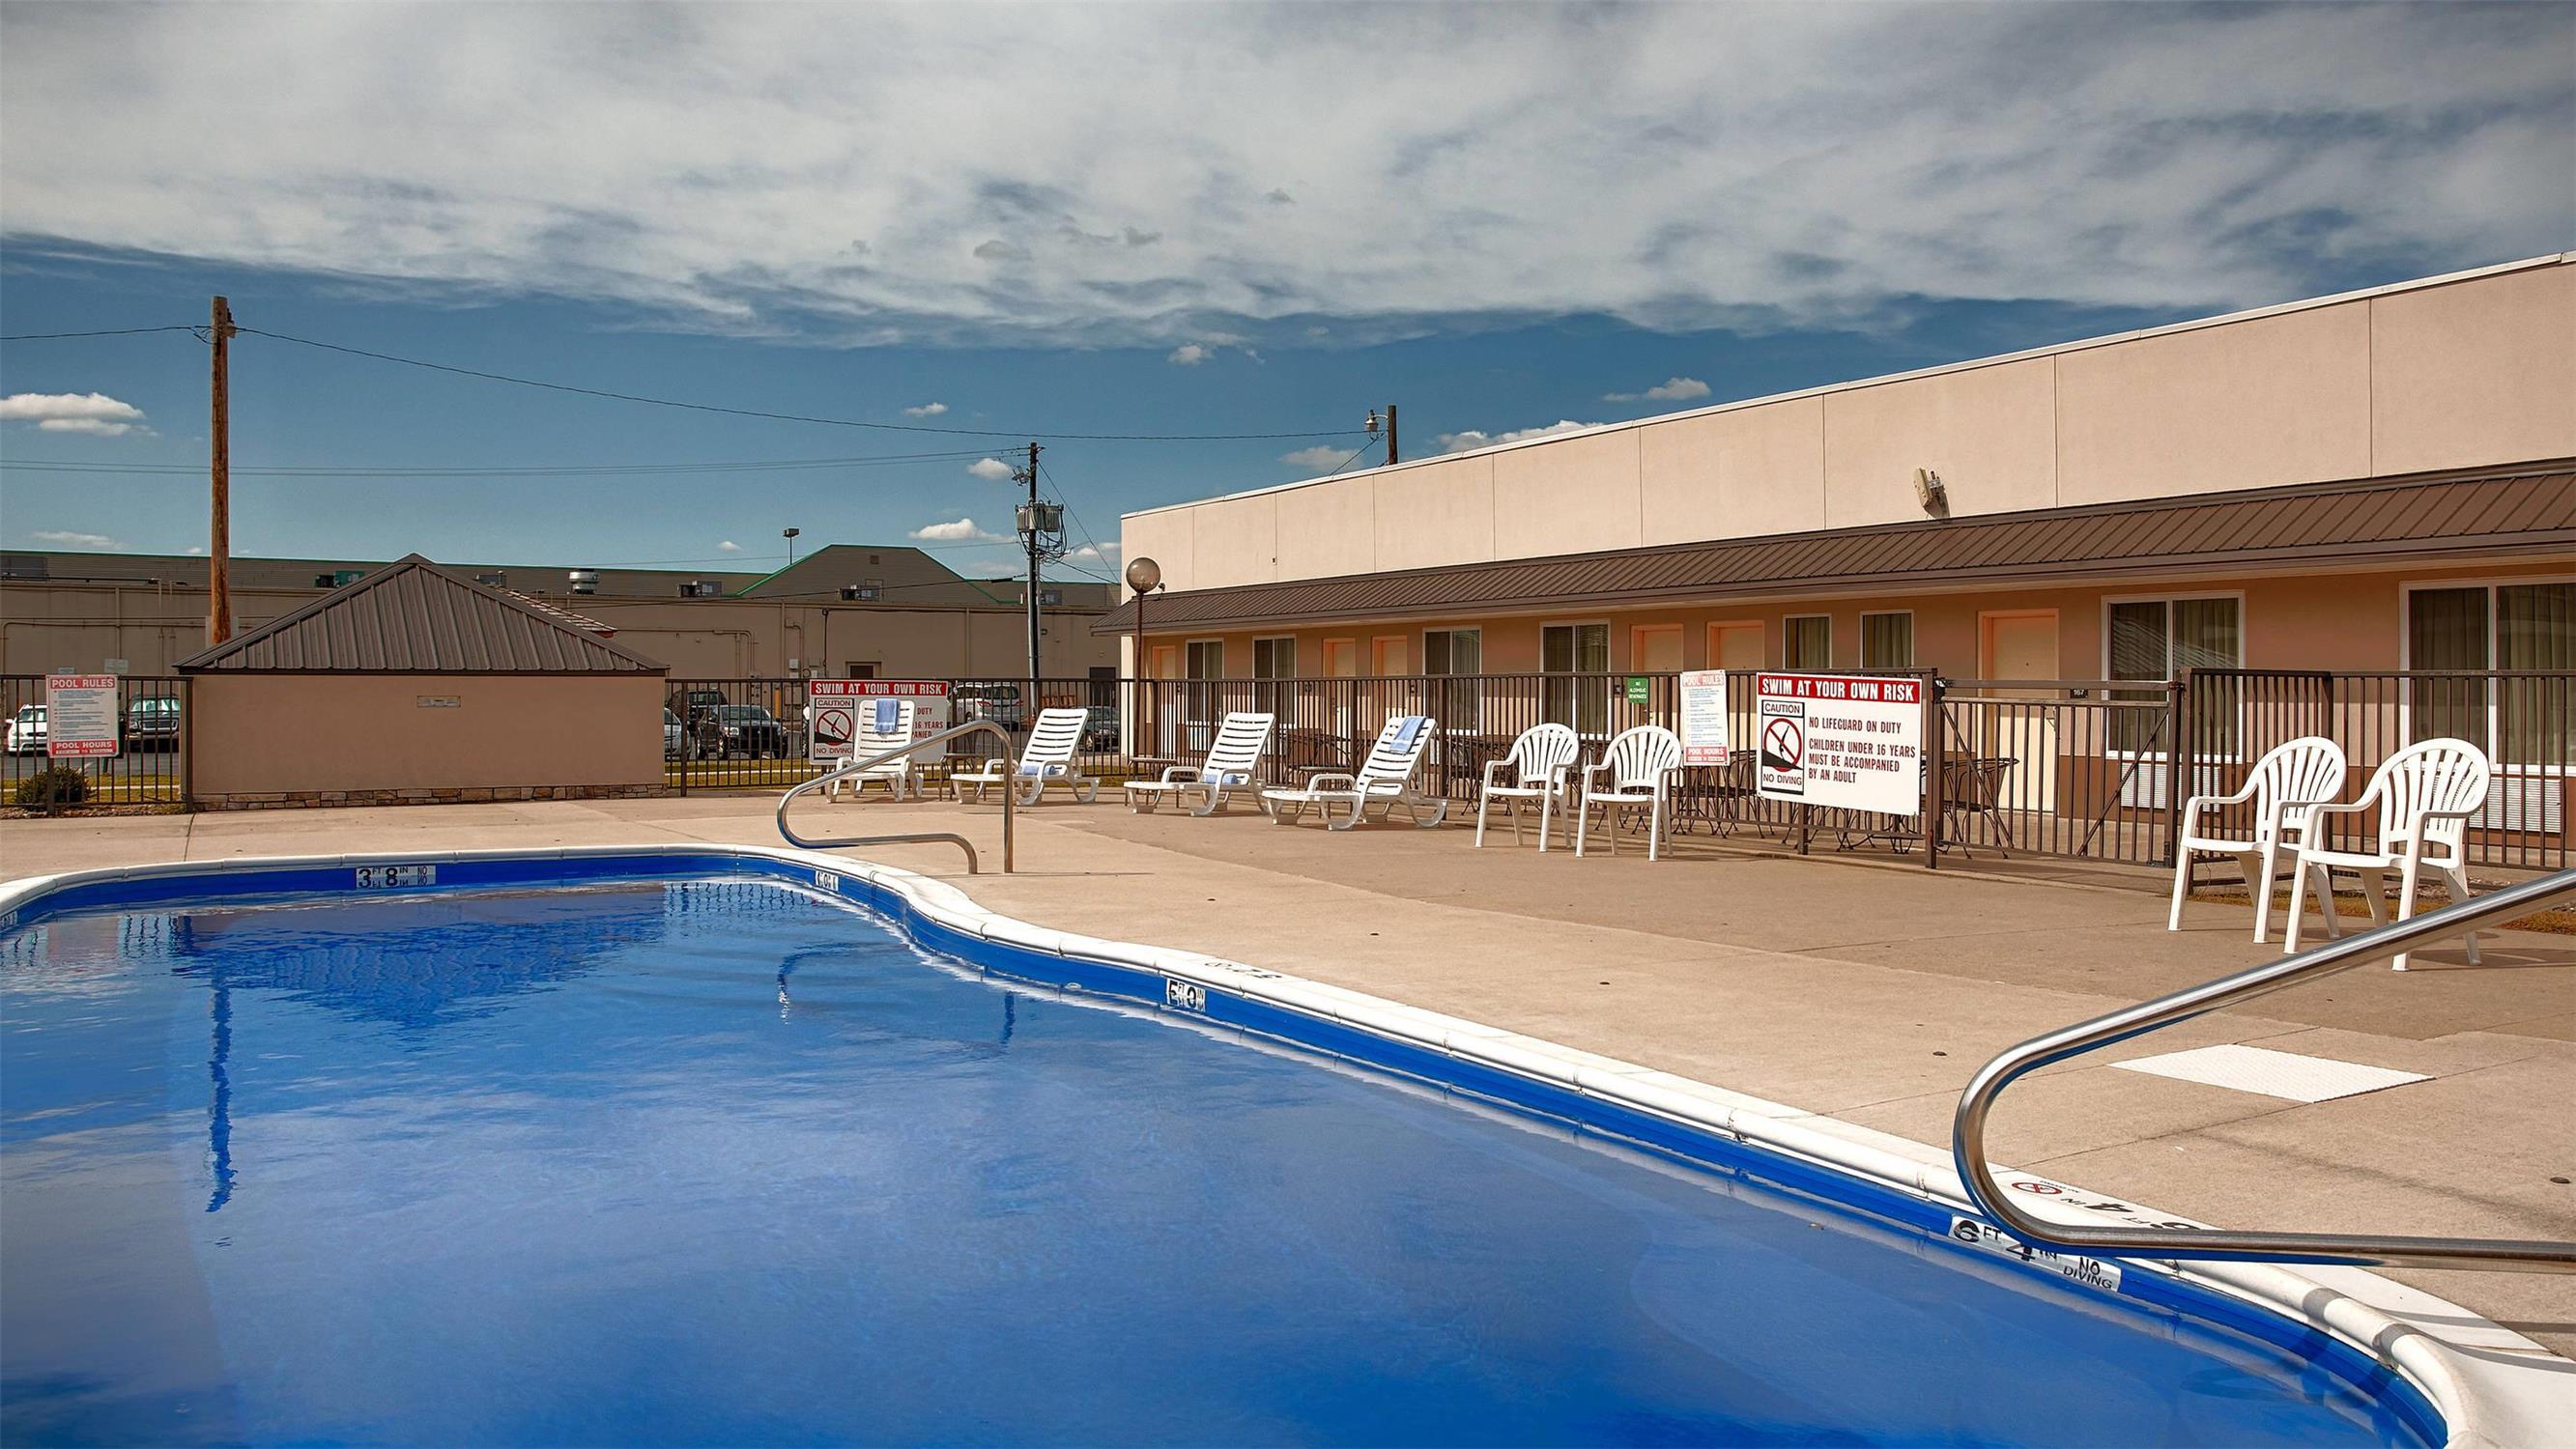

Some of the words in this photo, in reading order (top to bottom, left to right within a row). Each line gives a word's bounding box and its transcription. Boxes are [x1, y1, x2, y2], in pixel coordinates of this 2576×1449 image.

[52, 679, 79, 688] POOL
[82, 678, 114, 688] RULES
[816, 683, 844, 694] SWIM
[848, 683, 860, 694] AT
[865, 683, 889, 694] YOUR
[894, 684, 915, 694] OWN
[920, 684, 942, 695] RISK
[1762, 678, 1792, 695] SWIM
[1796, 679, 1812, 696] AT
[1815, 680, 1846, 698] YOUR
[1850, 682, 1878, 699] OWN
[1884, 684, 1914, 701] RISK
[1764, 702, 1800, 714] CAUTION
[1809, 717, 1819, 728] NO
[1822, 718, 1863, 732] LIFEGUARD
[1866, 721, 1877, 733] ON
[1880, 722, 1902, 734] DUTY
[1809, 738, 1845, 753] CHILDREN
[1847, 741, 1874, 754] UNDER
[1876, 744, 1886, 755] 16
[1889, 745, 1916, 758] YEARS
[1808, 753, 1828, 766] MUST
[1831, 755, 1841, 767] BE
[1844, 756, 1900, 773] ACCOMPANIED
[1763, 774, 1775, 783] NO
[1777, 775, 1803, 786] DIVING
[1808, 768, 1818, 780] BY
[1819, 770, 1831, 781] AN
[1833, 772, 1857, 784] ADULT
[358, 869, 372, 887] 3
[1954, 1220, 1980, 1242] 6
[1983, 1226, 2001, 1240] FT
[2005, 1242, 2036, 1262] 4
[2079, 1256, 2101, 1276] NO
[2063, 1265, 2113, 1290] DIVING
